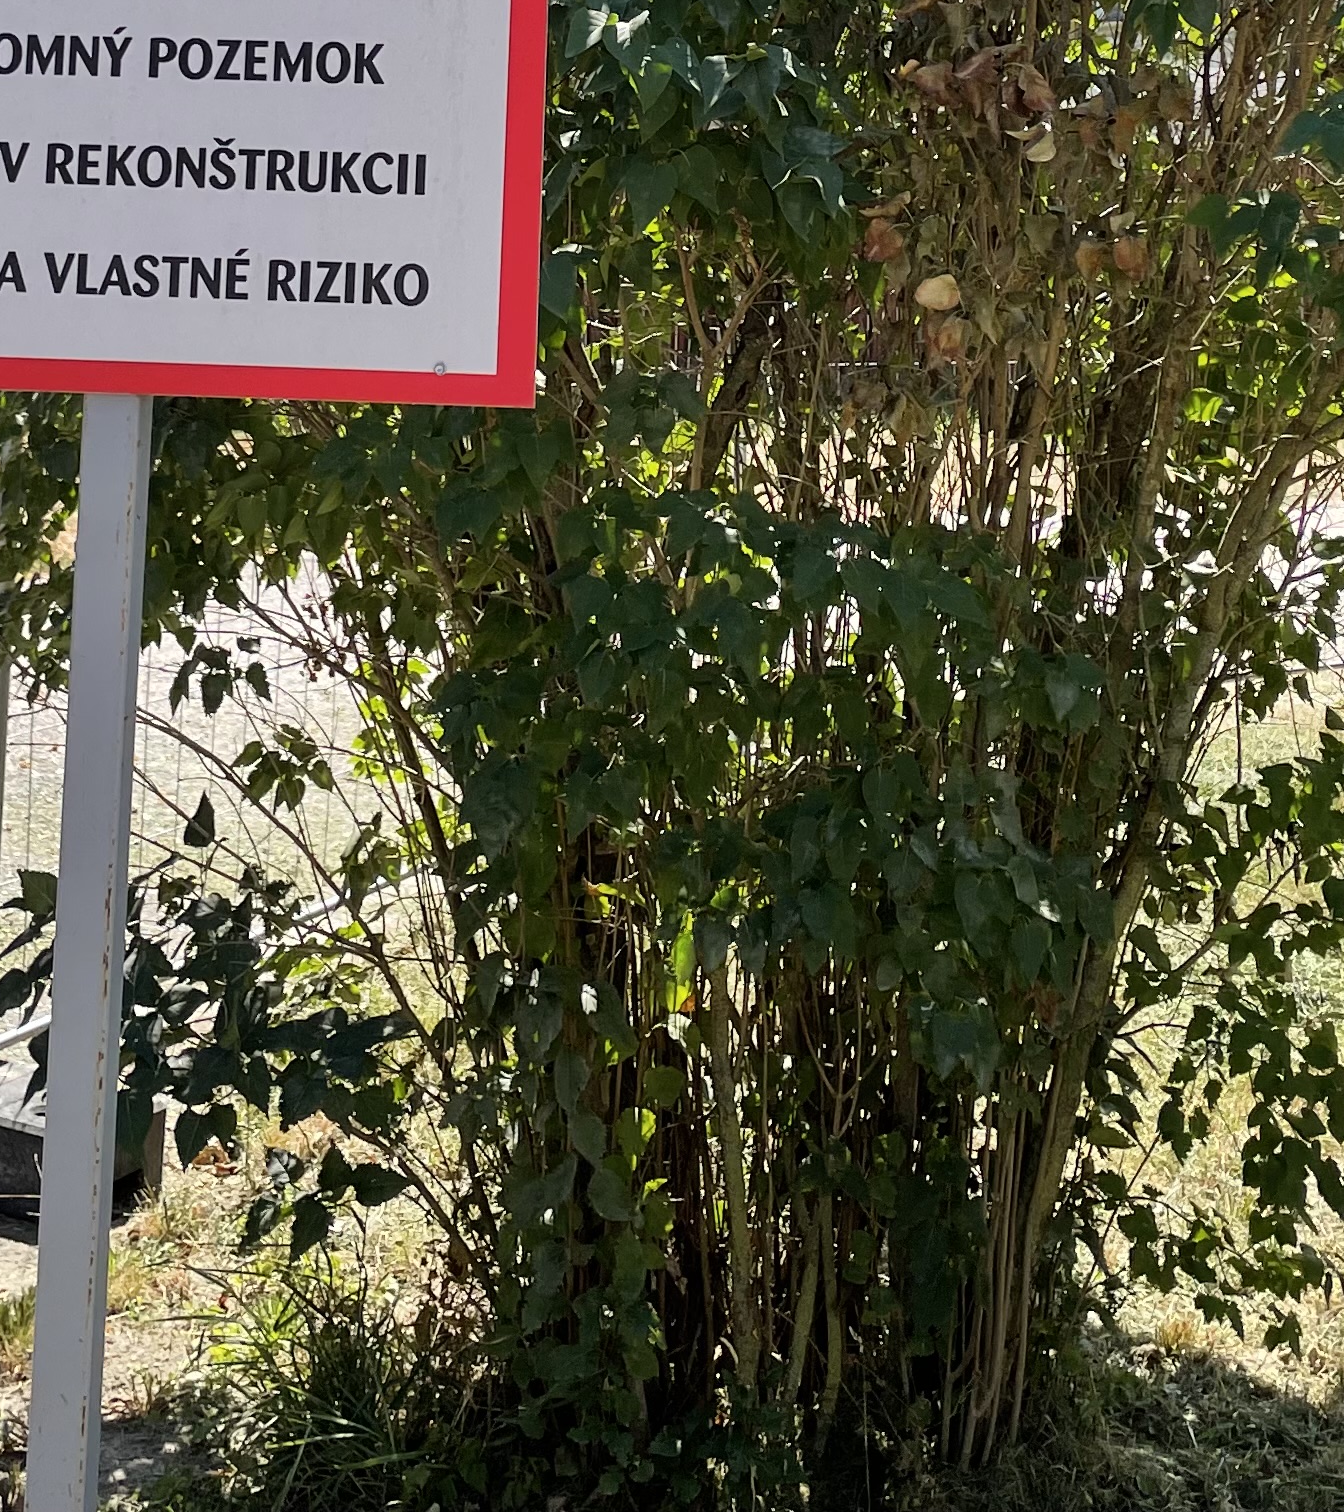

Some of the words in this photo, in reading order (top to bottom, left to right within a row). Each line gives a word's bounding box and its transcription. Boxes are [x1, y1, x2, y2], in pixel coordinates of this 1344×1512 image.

[148, 37, 385, 86] POZEMOK
[45, 137, 428, 196] REKONŠTRUKCII
[43, 249, 250, 300] VLASTNÉ
[267, 259, 430, 307] RIZIKO
